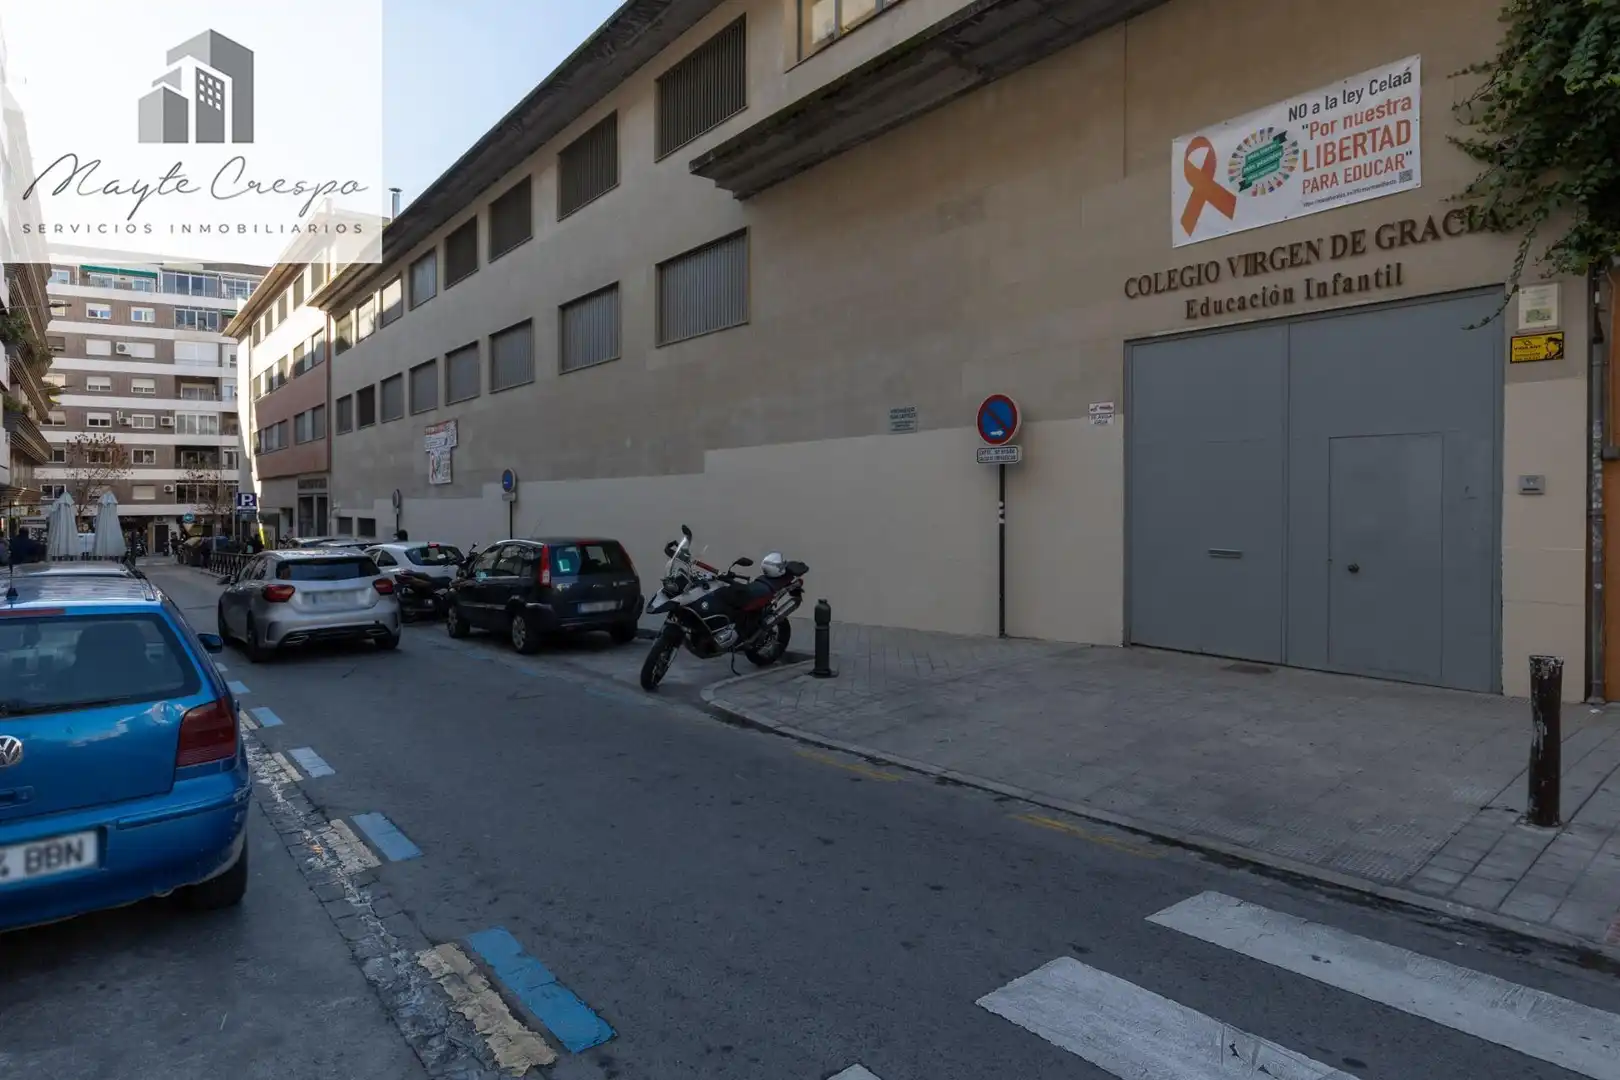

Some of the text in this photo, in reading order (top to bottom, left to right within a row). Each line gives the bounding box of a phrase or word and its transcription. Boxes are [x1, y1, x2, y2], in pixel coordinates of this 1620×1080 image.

[1288, 66, 1412, 122] NO a la ley Celaá
[1343, 95, 1412, 130] nuestra
[1303, 118, 1412, 173] LIBERTAD
[1302, 171, 1340, 195] PARA
[1124, 260, 1221, 300] COLEGIO
[1227, 238, 1324, 279] VIRGEN
[1330, 229, 1367, 260] DE
[1185, 262, 1404, 320] Educación Infantil
[241, 493, 254, 506] P
